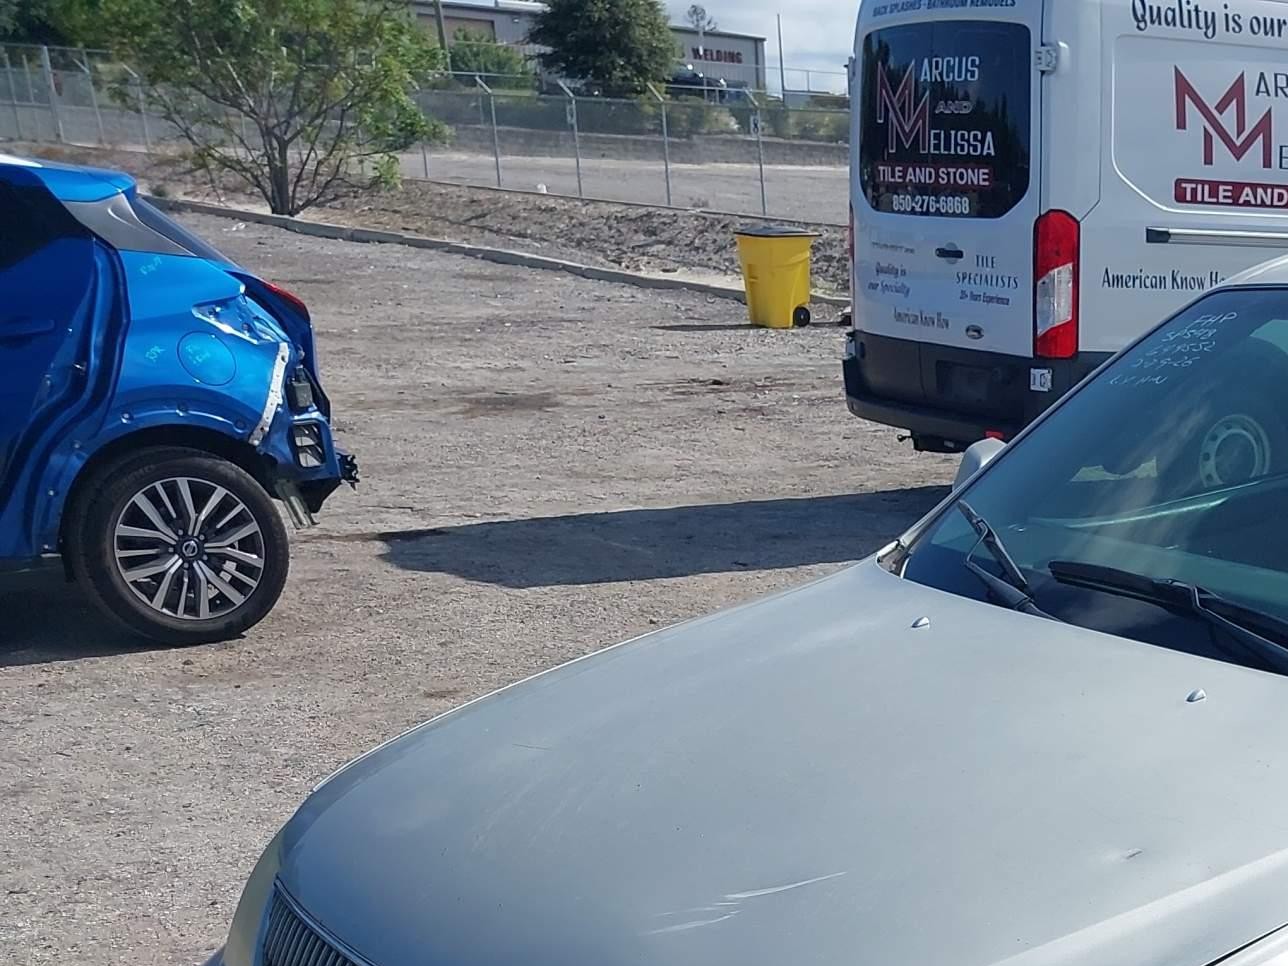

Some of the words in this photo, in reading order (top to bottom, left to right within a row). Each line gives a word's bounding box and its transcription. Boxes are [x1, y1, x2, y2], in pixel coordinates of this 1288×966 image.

[1132, 0, 1216, 39] Quality
[1224, 4, 1242, 34] is
[1250, 15, 1287, 38] our
[692, 47, 743, 64] WELDING
[935, 100, 974, 114] AND
[878, 165, 903, 182] TILE
[906, 166, 935, 184] AND
[939, 167, 989, 185] STONE
[892, 194, 970, 214] 850-276-6868
[1181, 183, 1233, 204] TILE
[1238, 188, 1288, 207] AND
[976, 254, 996, 269] TILE
[956, 271, 1018, 290] SPECIALISTS
[1102, 266, 1167, 289] American
[1171, 269, 1206, 291] Know
